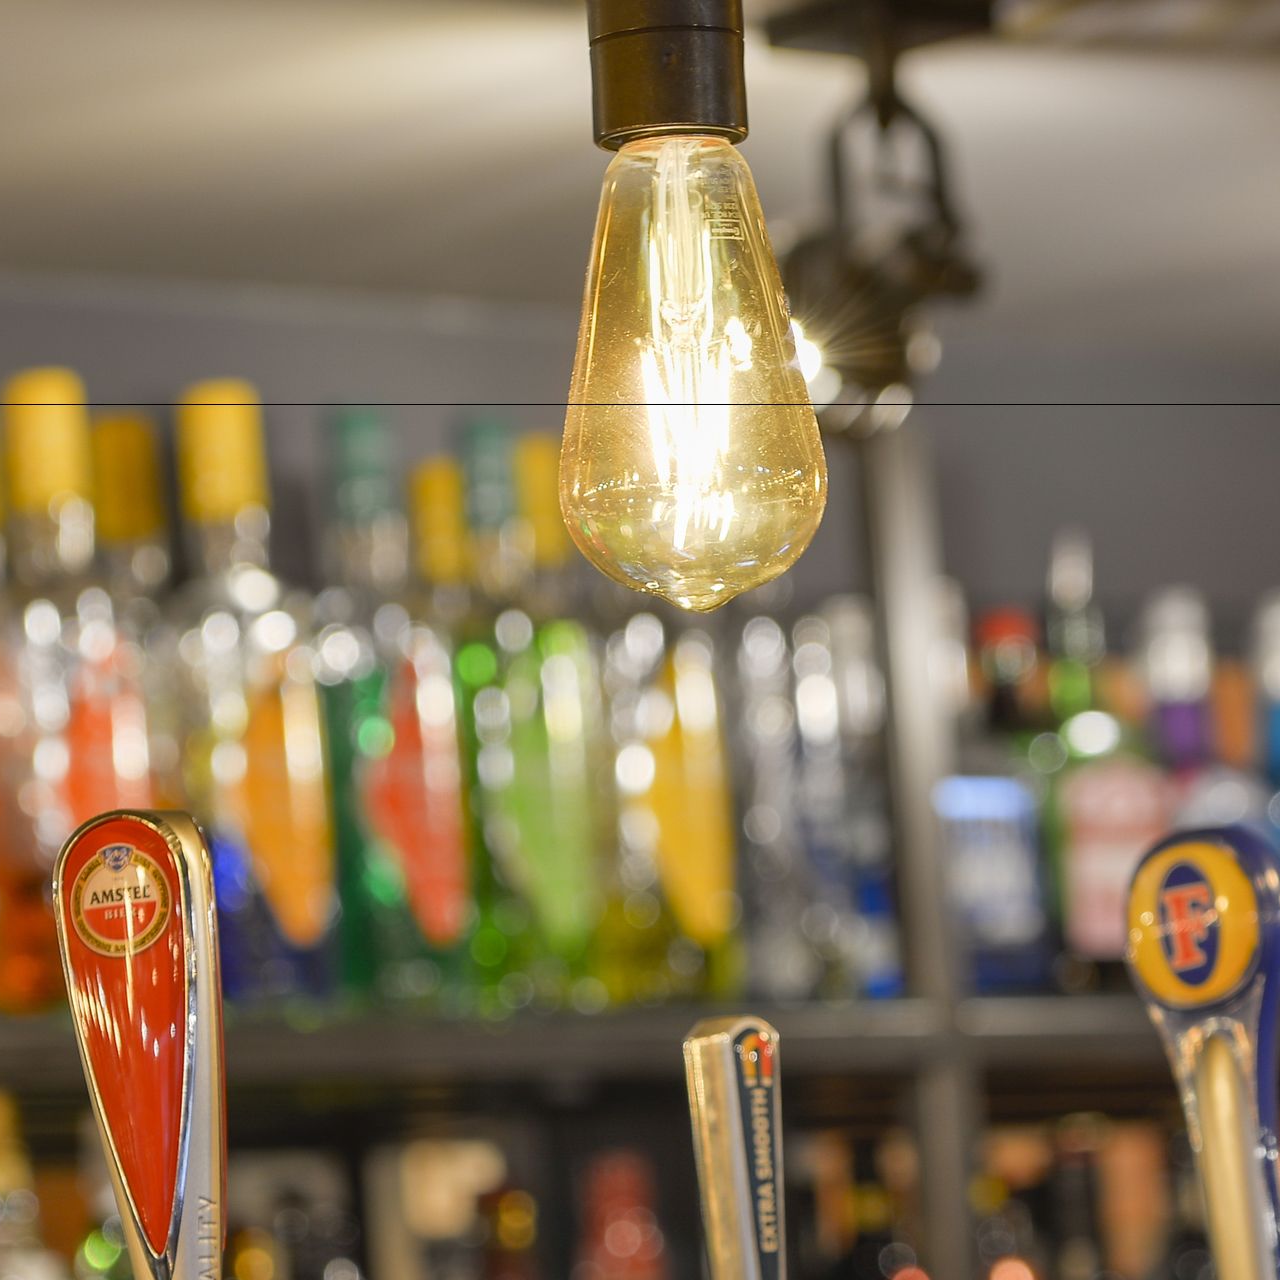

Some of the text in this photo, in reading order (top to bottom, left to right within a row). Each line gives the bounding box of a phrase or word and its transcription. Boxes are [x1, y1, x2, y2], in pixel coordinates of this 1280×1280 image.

[1162, 886, 1211, 969] F
[752, 1089, 777, 1253] EXTRA SMOOTH
